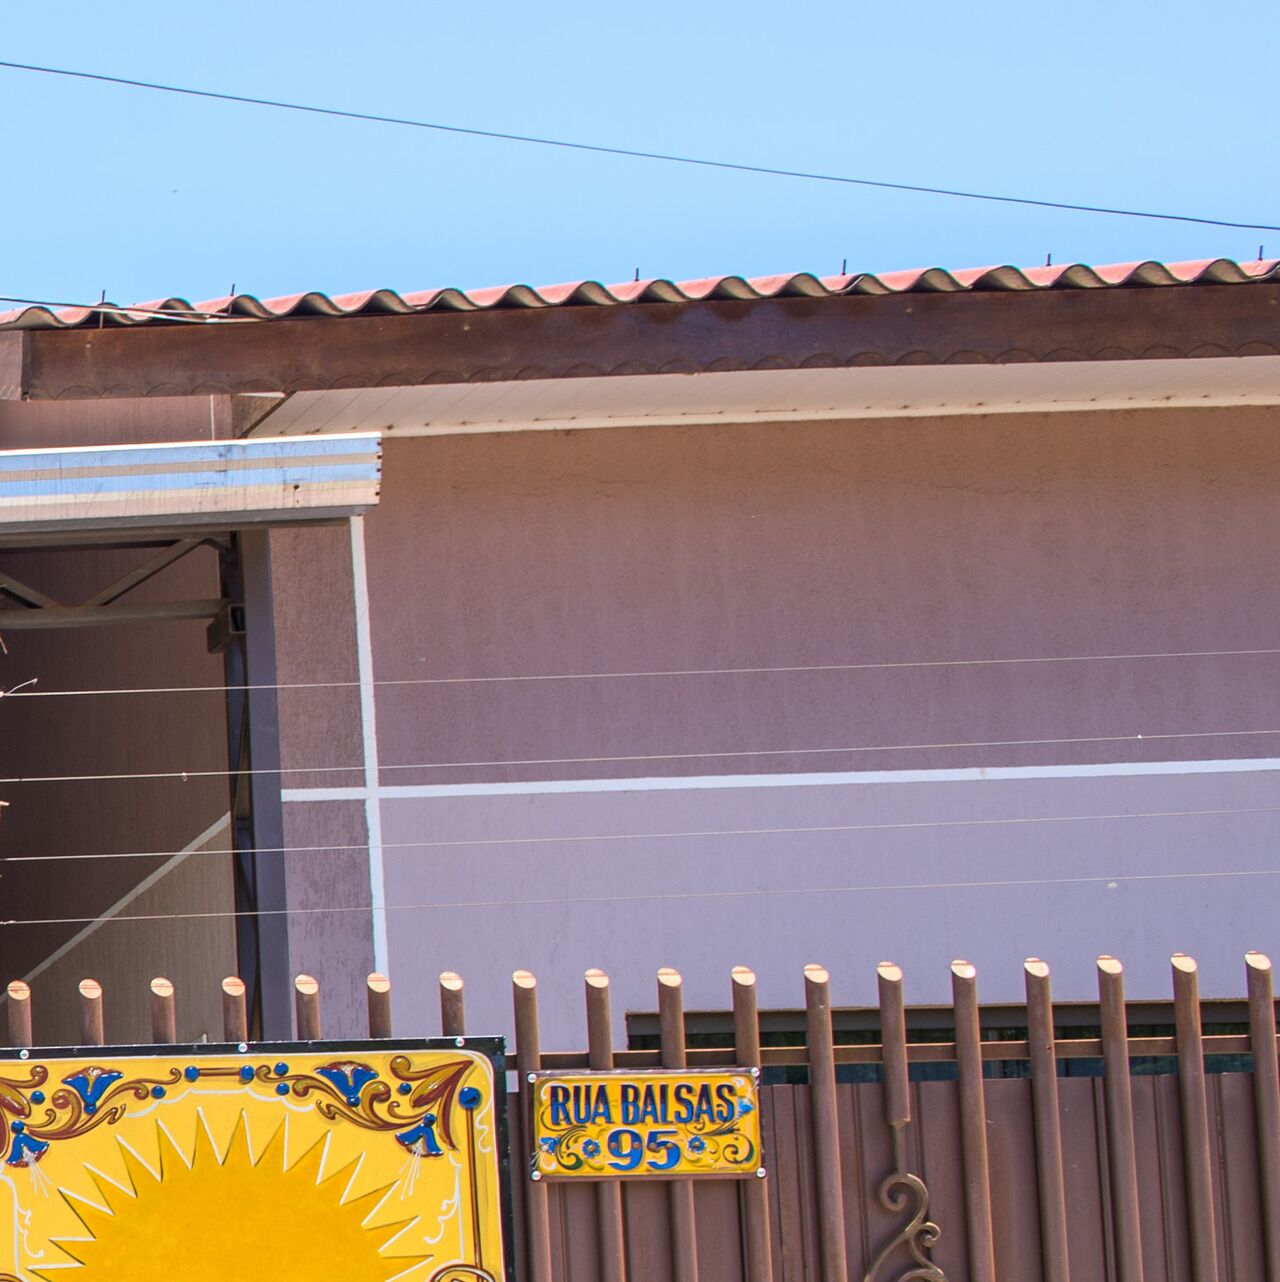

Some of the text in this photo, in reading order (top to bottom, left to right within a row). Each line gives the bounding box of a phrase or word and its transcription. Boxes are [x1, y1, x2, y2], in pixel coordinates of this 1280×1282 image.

[550, 1083, 737, 1126] RUA BALSAS
[607, 1128, 682, 1171] 95
